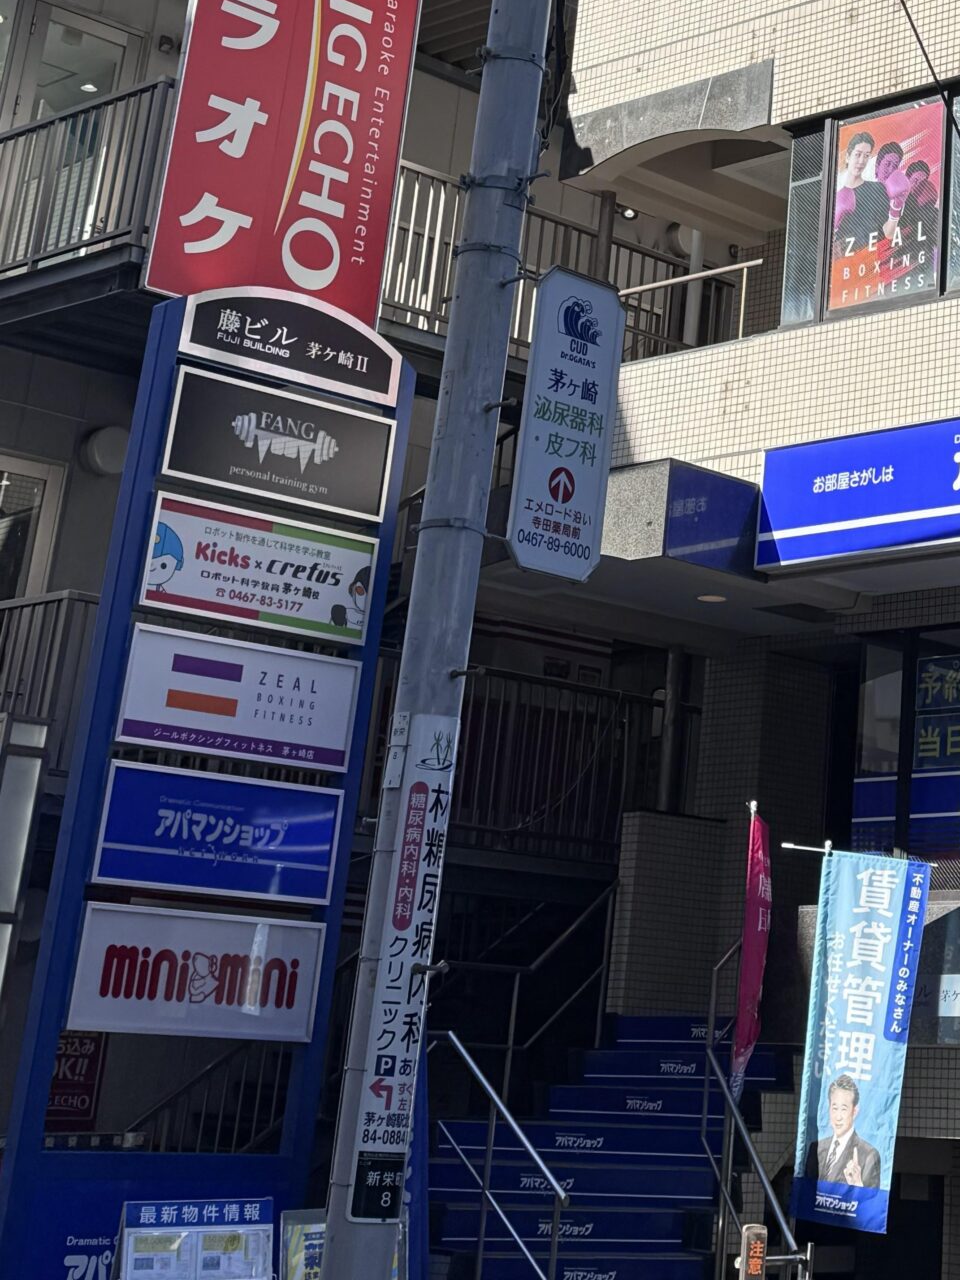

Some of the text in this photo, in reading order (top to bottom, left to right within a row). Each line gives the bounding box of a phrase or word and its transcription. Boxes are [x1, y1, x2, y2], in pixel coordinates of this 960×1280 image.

[281, 85, 361, 291] ECHO
[351, 86, 390, 266] Entertainment
[844, 221, 926, 257] ZEAL
[843, 251, 925, 280] BOXING
[842, 274, 924, 303] FITNESS
[217, 308, 298, 346] 藤ビル
[217, 332, 290, 358] FUJI BUILDING
[570, 339, 588, 357] CUD
[260, 411, 315, 440] FANG
[534, 394, 604, 438] 泌尿器科
[229, 465, 328, 495] personal training gym
[813, 465, 894, 493] お部屋さがしは
[524, 498, 591, 526] エメロード沿い
[532, 516, 581, 540] 寺田薬局前
[195, 541, 251, 569] Kicks
[518, 529, 590, 560] 0467-89-6000
[228, 589, 303, 613] 0467-83-5177
[259, 671, 317, 694] ZEAL
[257, 692, 315, 710] BOXING
[254, 709, 312, 726] FITNESS
[153, 728, 273, 753] ジールボクシングフィットネス
[155, 808, 288, 849] アパマンショップ
[396, 793, 426, 920] 糖尿病内科・内科
[890, 872, 924, 1034] 不動産オーナーのみなさん
[835, 867, 899, 1081] 賃貸管理
[377, 936, 408, 1051] クリニック
[139, 1203, 261, 1224] 最新物件情報
[381, 1191, 392, 1208] 8
[66, 1235, 111, 1247] Dramatic
[748, 1240, 764, 1275] 注意
